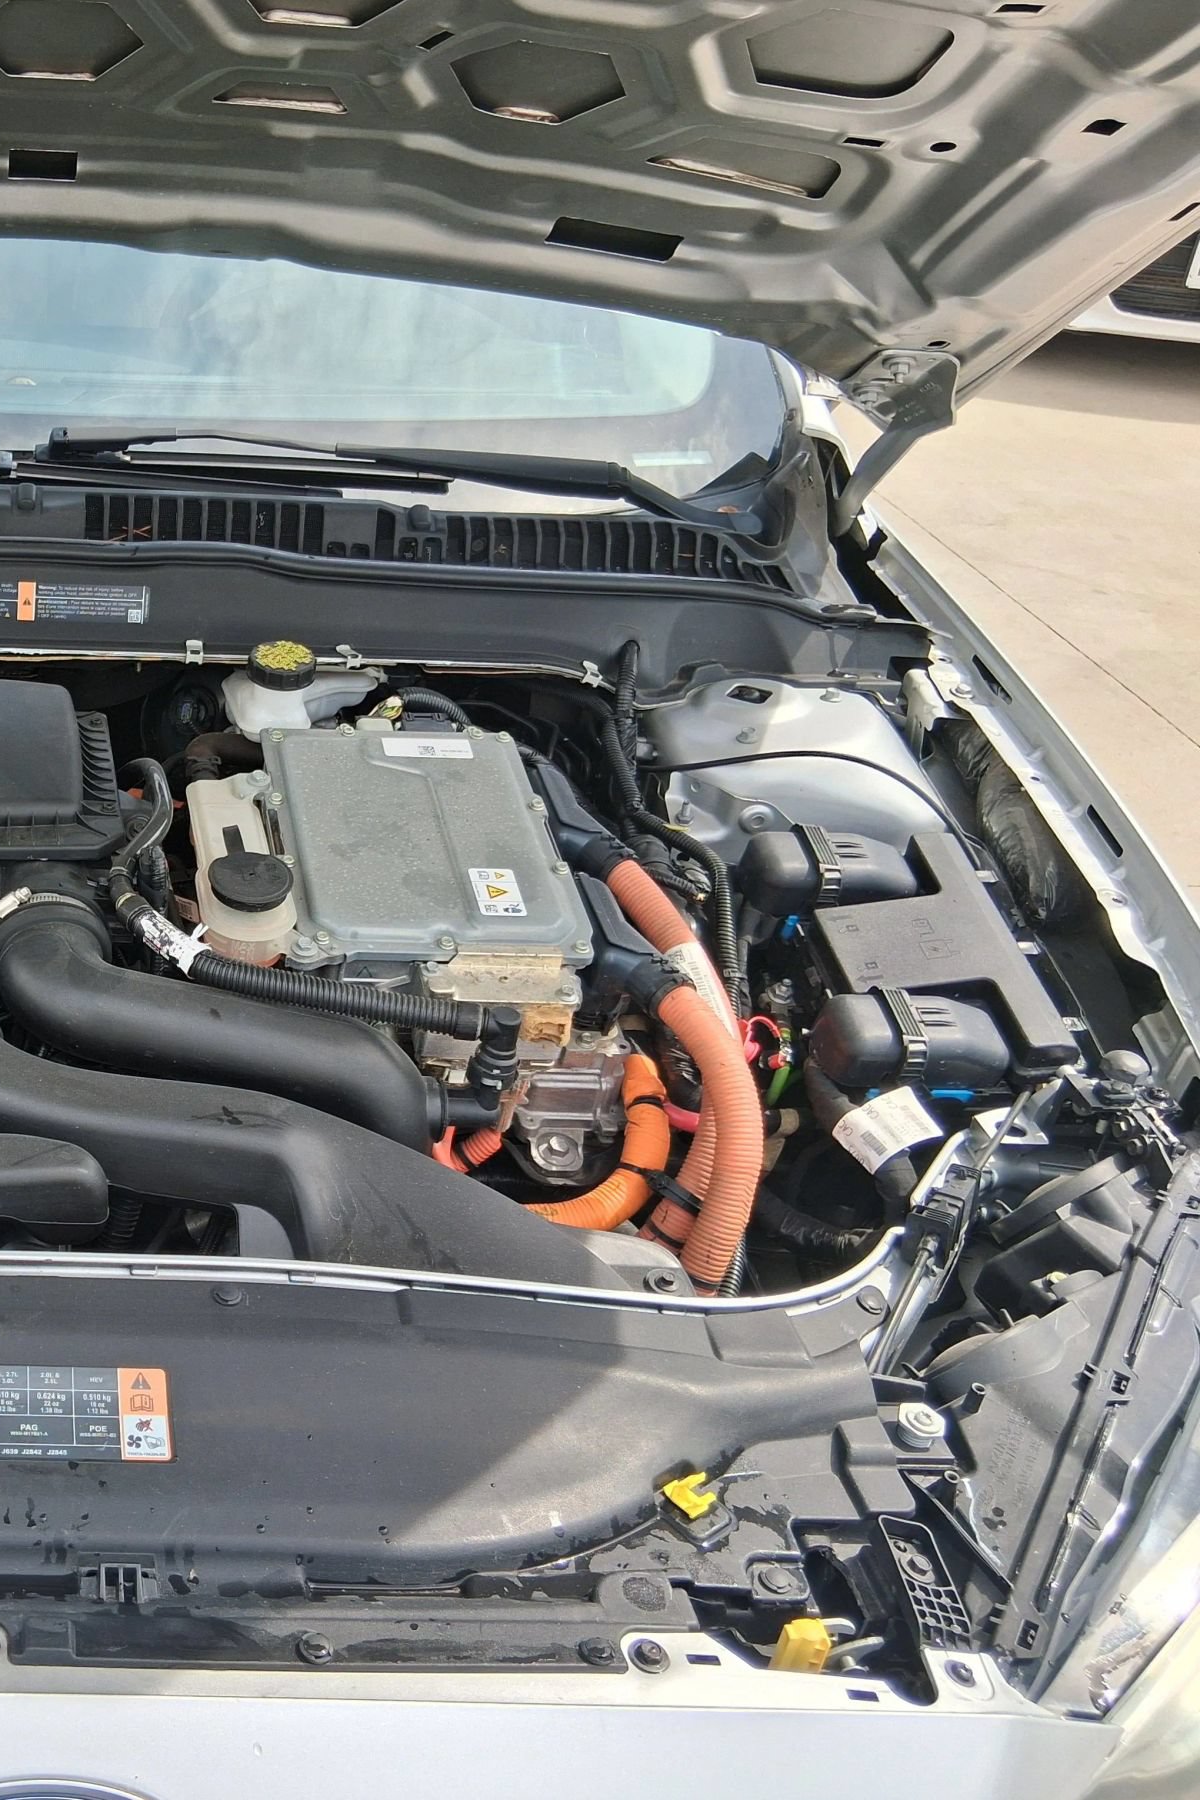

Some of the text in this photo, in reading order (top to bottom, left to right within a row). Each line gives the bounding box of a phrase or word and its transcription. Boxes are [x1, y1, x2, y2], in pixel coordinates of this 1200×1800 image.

[862, 1104, 879, 1120] CAC
[838, 1120, 853, 1137] CAC
[11, 1392, 19, 1400] kg
[57, 1392, 65, 1401] kg
[102, 1394, 111, 1402] kg
